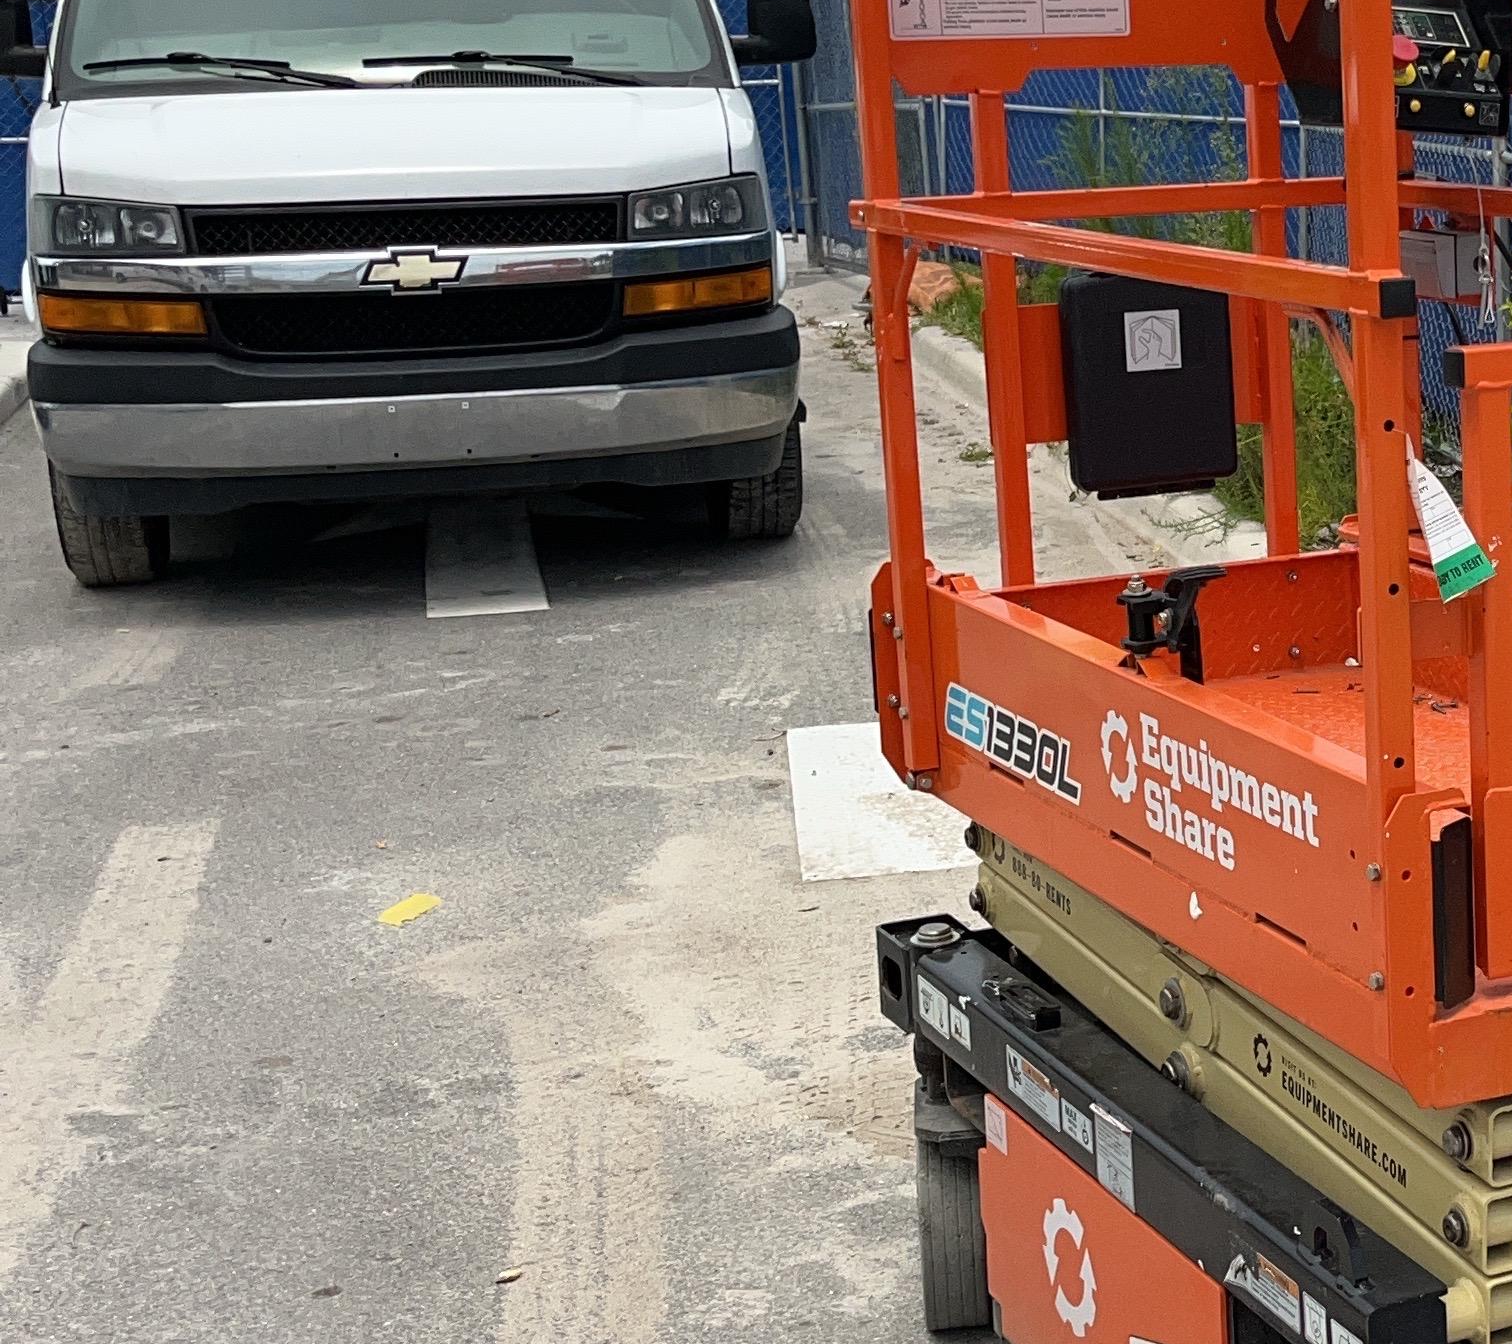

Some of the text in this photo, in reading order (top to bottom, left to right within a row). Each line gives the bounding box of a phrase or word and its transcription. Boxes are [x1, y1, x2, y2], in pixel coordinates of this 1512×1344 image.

[1461, 553, 1484, 574] RENT
[945, 682, 1082, 807] ES1330L
[1139, 711, 1320, 848] Equipment
[1144, 777, 1236, 872] Share
[1281, 1069, 1407, 1189] EQUIPMENTSHARE.COM
